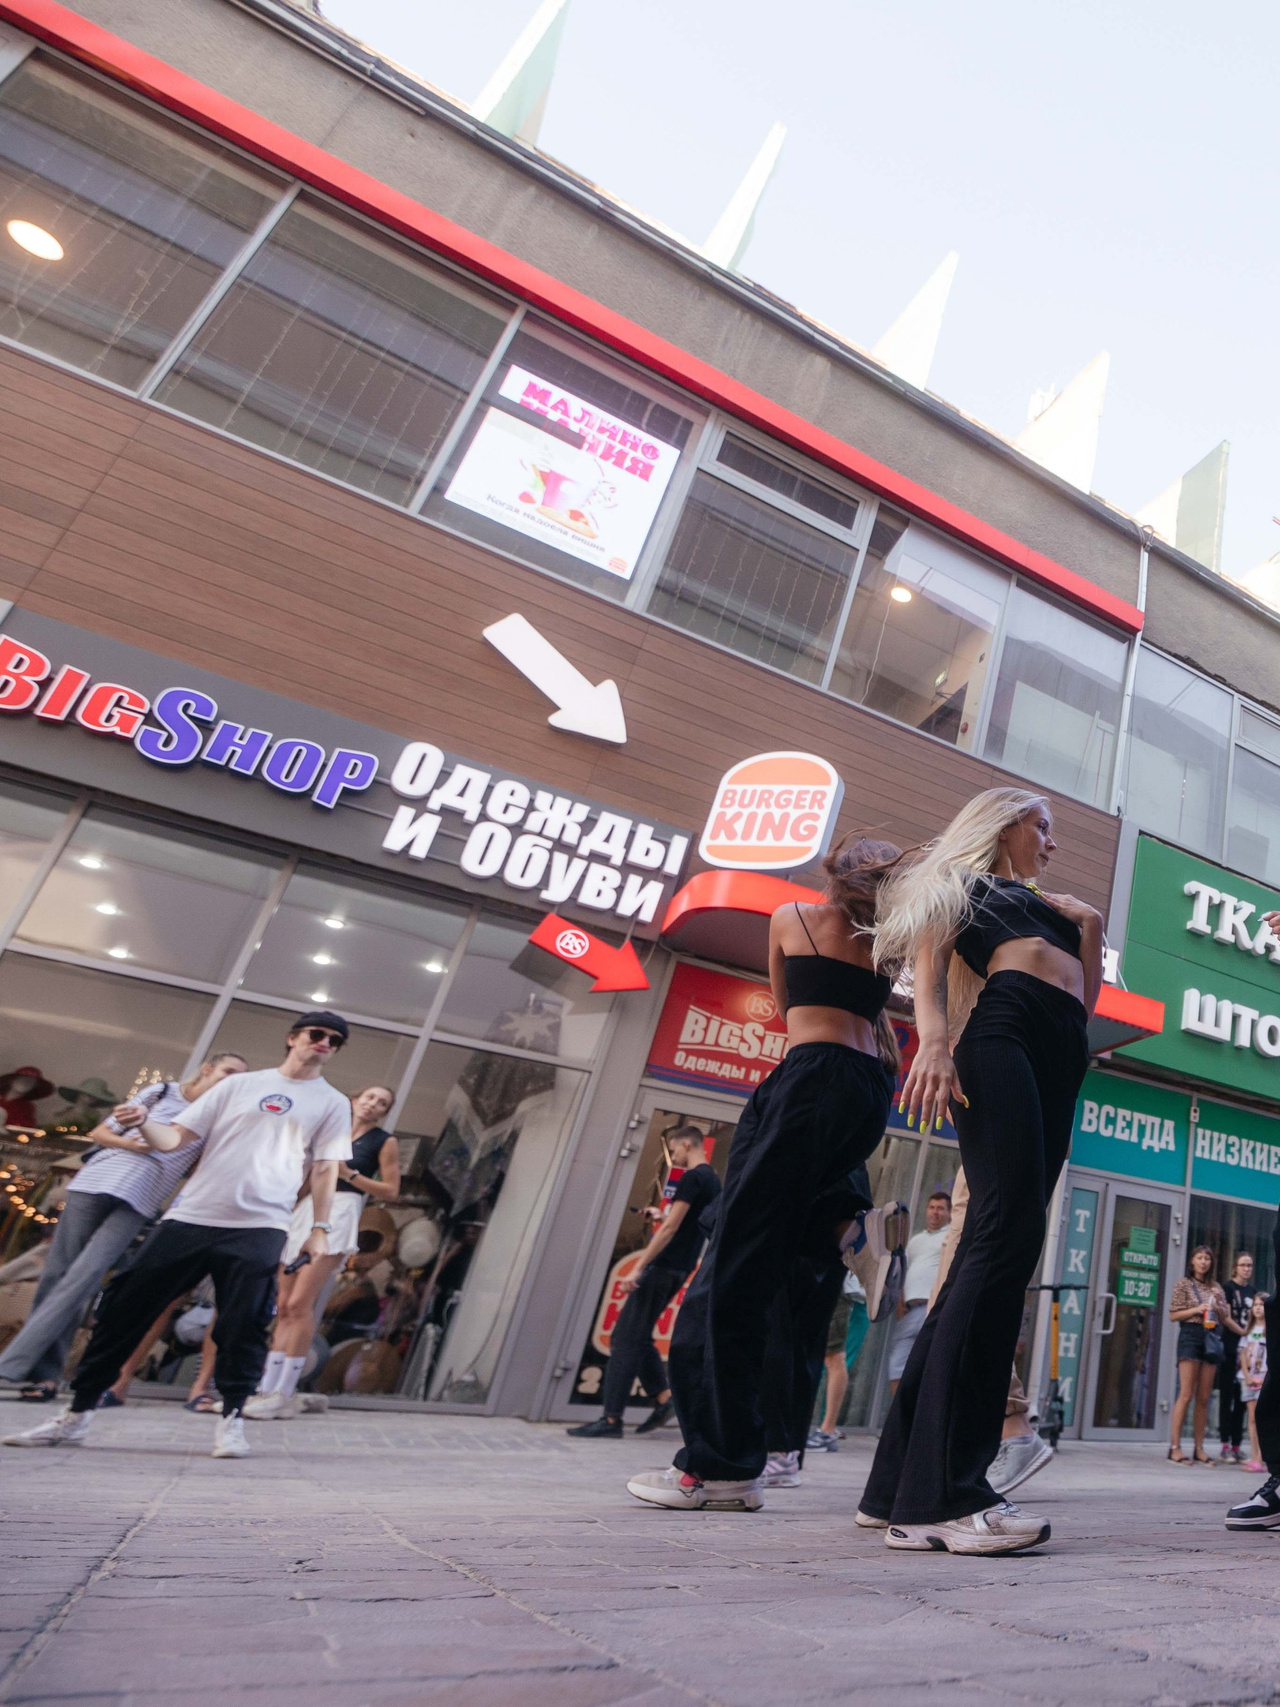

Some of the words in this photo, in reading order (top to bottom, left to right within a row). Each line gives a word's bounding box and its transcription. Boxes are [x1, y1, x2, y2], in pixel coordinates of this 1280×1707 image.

[522, 381, 660, 460] МАЛИНО
[486, 493, 520, 515] Когда
[390, 741, 689, 877] Одежды
[719, 788, 828, 810] BURGER
[709, 811, 821, 842] KING
[460, 821, 664, 923] Обуви
[559, 932, 585, 955] BS
[751, 995, 775, 1018] BS
[678, 1007, 790, 1059] BIGSH
[673, 1051, 746, 1079] Одежды
[1080, 1099, 1176, 1152] ВСЕГДА
[1123, 1251, 1159, 1267] ОТКРЫТО
